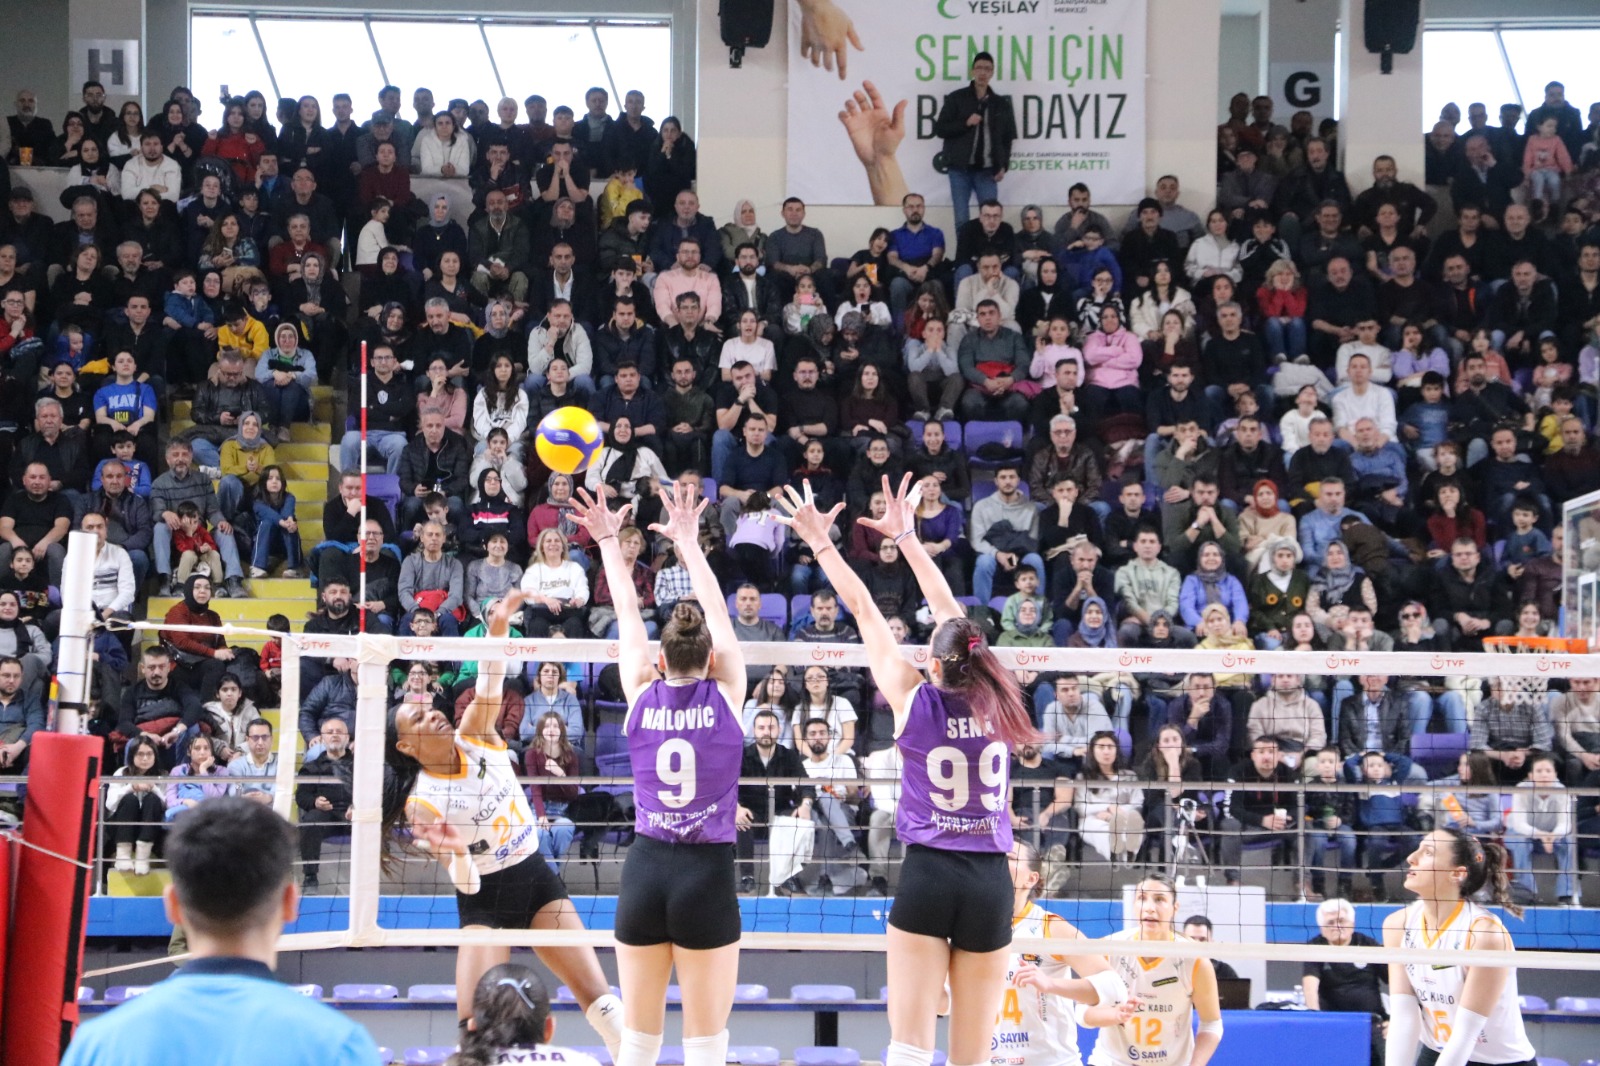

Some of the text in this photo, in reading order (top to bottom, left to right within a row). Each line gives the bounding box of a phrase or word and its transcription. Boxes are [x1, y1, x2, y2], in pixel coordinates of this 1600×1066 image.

[1048, 26, 1123, 88] İÇİN
[88, 48, 123, 85] H
[1284, 71, 1321, 108] G
[1068, 160, 1110, 171] HATTI
[312, 642, 331, 650] TVF
[415, 645, 434, 653] TVF
[519, 646, 538, 655] TVF
[827, 650, 845, 659] TVF
[1032, 655, 1050, 663] TVF
[1134, 656, 1153, 665] TVF
[1237, 657, 1256, 666] TVF
[1341, 658, 1360, 667] TVF
[1446, 659, 1465, 668] TVF
[1552, 661, 1571, 669] TVF
[656, 738, 697, 808] 9
[926, 741, 1008, 812] 99
[492, 799, 525, 845] 21
[1148, 1004, 1174, 1013] KABLO
[1131, 1017, 1162, 1046] 12
[1000, 1032, 1029, 1044] SAYIN
